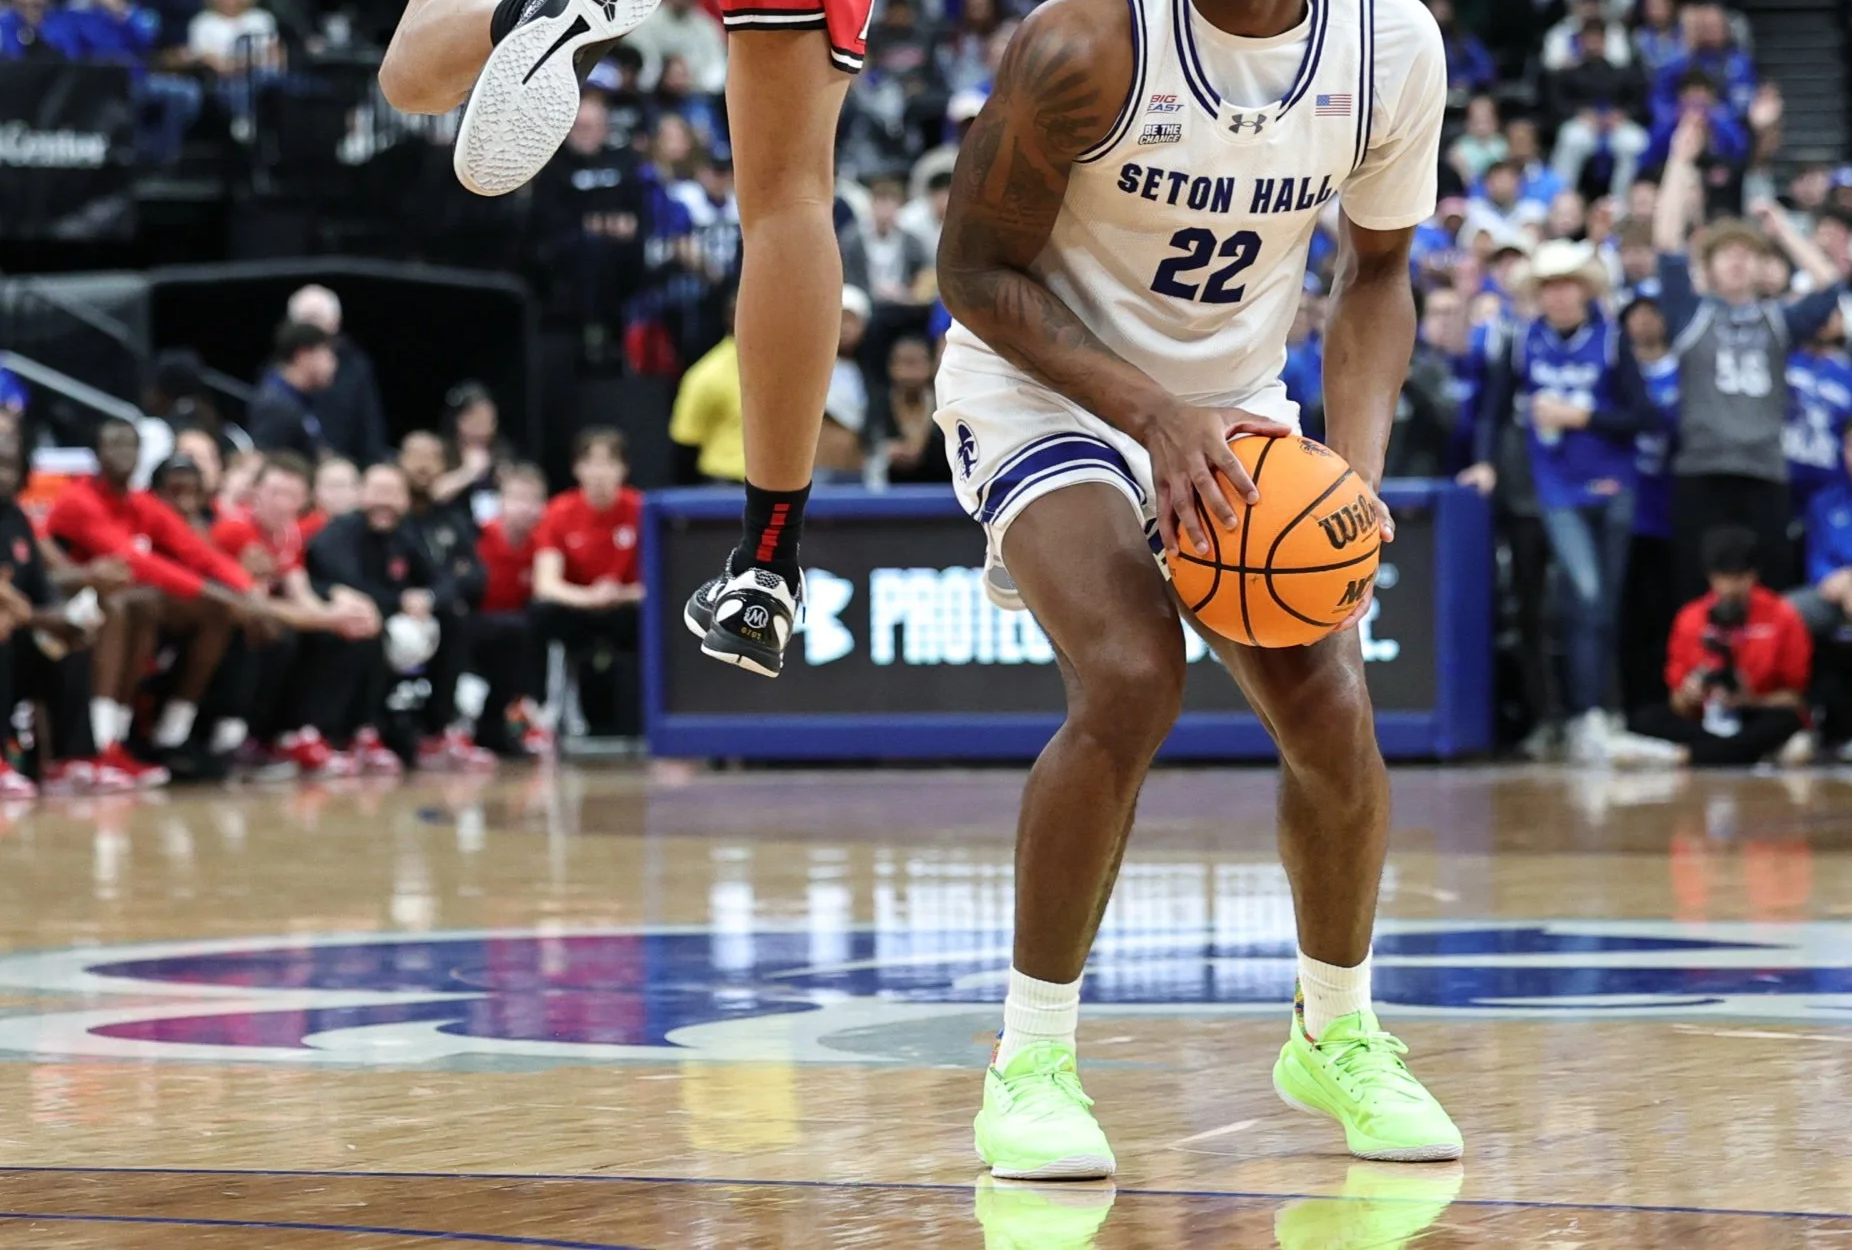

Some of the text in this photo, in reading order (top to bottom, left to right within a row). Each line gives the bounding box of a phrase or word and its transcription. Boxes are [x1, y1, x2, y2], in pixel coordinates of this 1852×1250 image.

[1150, 94, 1178, 104] BIG
[1147, 103, 1184, 112] EAST
[1144, 124, 1181, 135] BE THE
[1139, 134, 1181, 145] CHANGE
[1117, 163, 1332, 214] SETON HALL
[1150, 227, 1262, 304] 22
[1317, 492, 1377, 551] Wil
